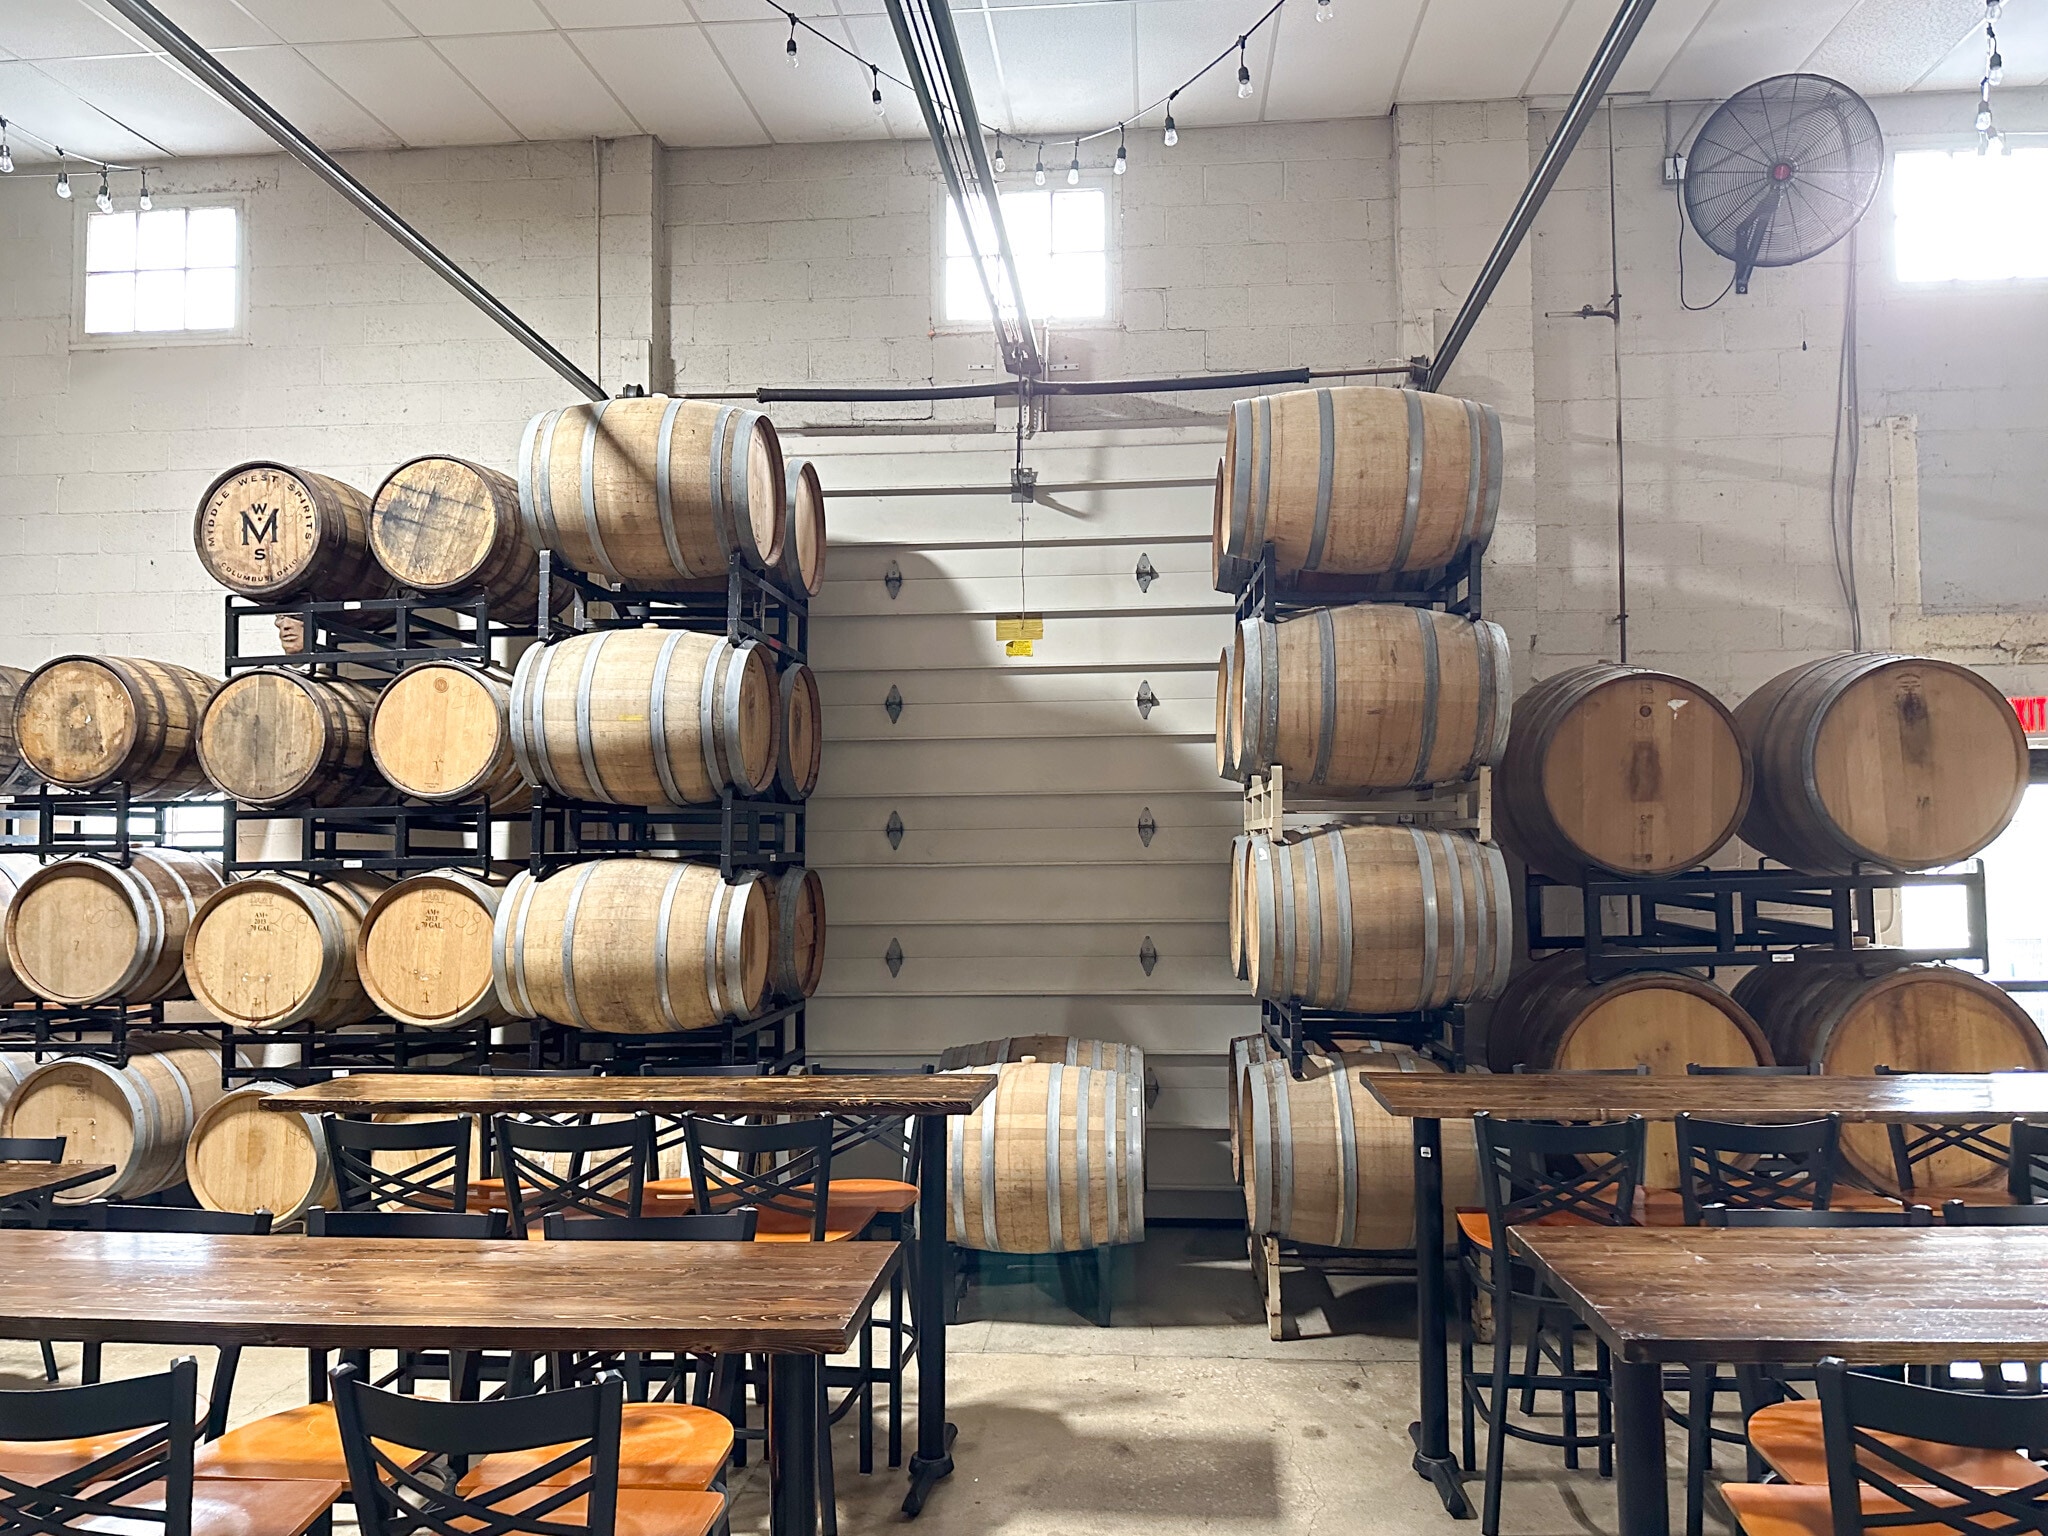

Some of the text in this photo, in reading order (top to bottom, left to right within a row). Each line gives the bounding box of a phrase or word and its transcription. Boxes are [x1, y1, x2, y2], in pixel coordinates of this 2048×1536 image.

[207, 474, 313, 547] MIDDLE WEST SPIRITS
[276, 558, 298, 577] OHIO
[2009, 697, 2047, 733] XIT
